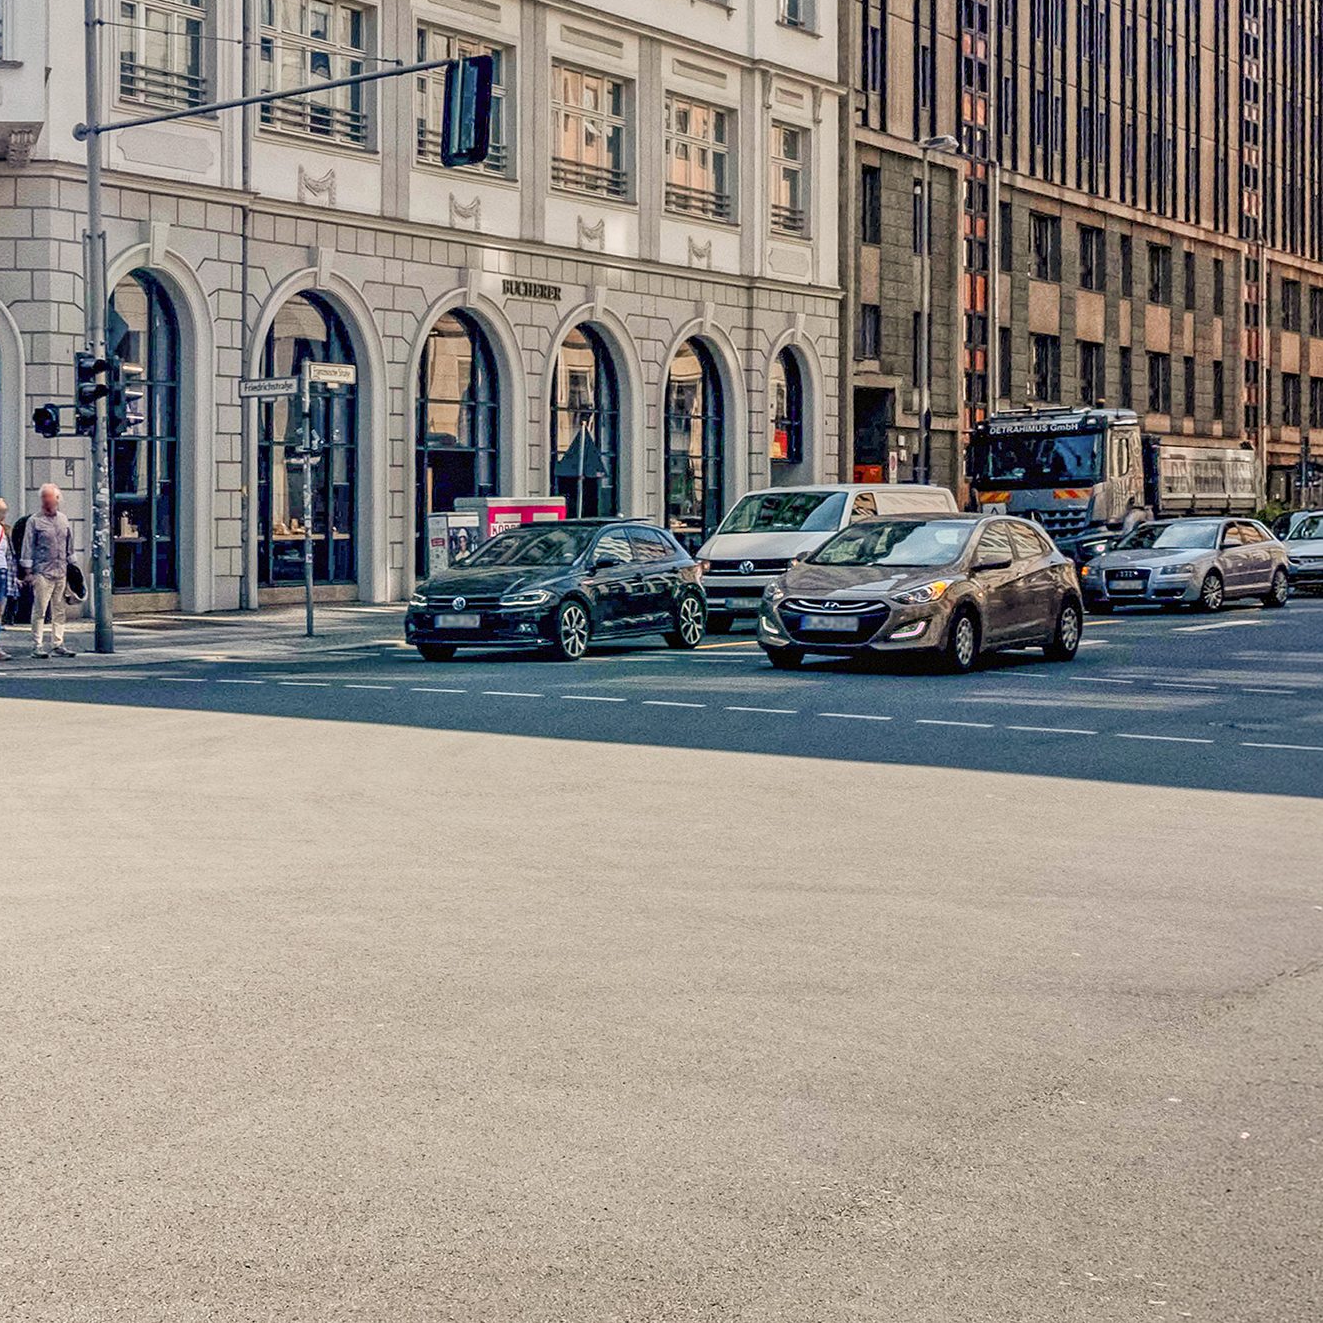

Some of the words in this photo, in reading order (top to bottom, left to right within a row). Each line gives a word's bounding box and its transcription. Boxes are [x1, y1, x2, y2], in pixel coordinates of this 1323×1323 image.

[502, 279, 561, 301] BUCHERER
[244, 381, 294, 392] Friedrichstraße
[989, 424, 1048, 435] DETRAHIMUS
[1050, 423, 1079, 432] GmbH
